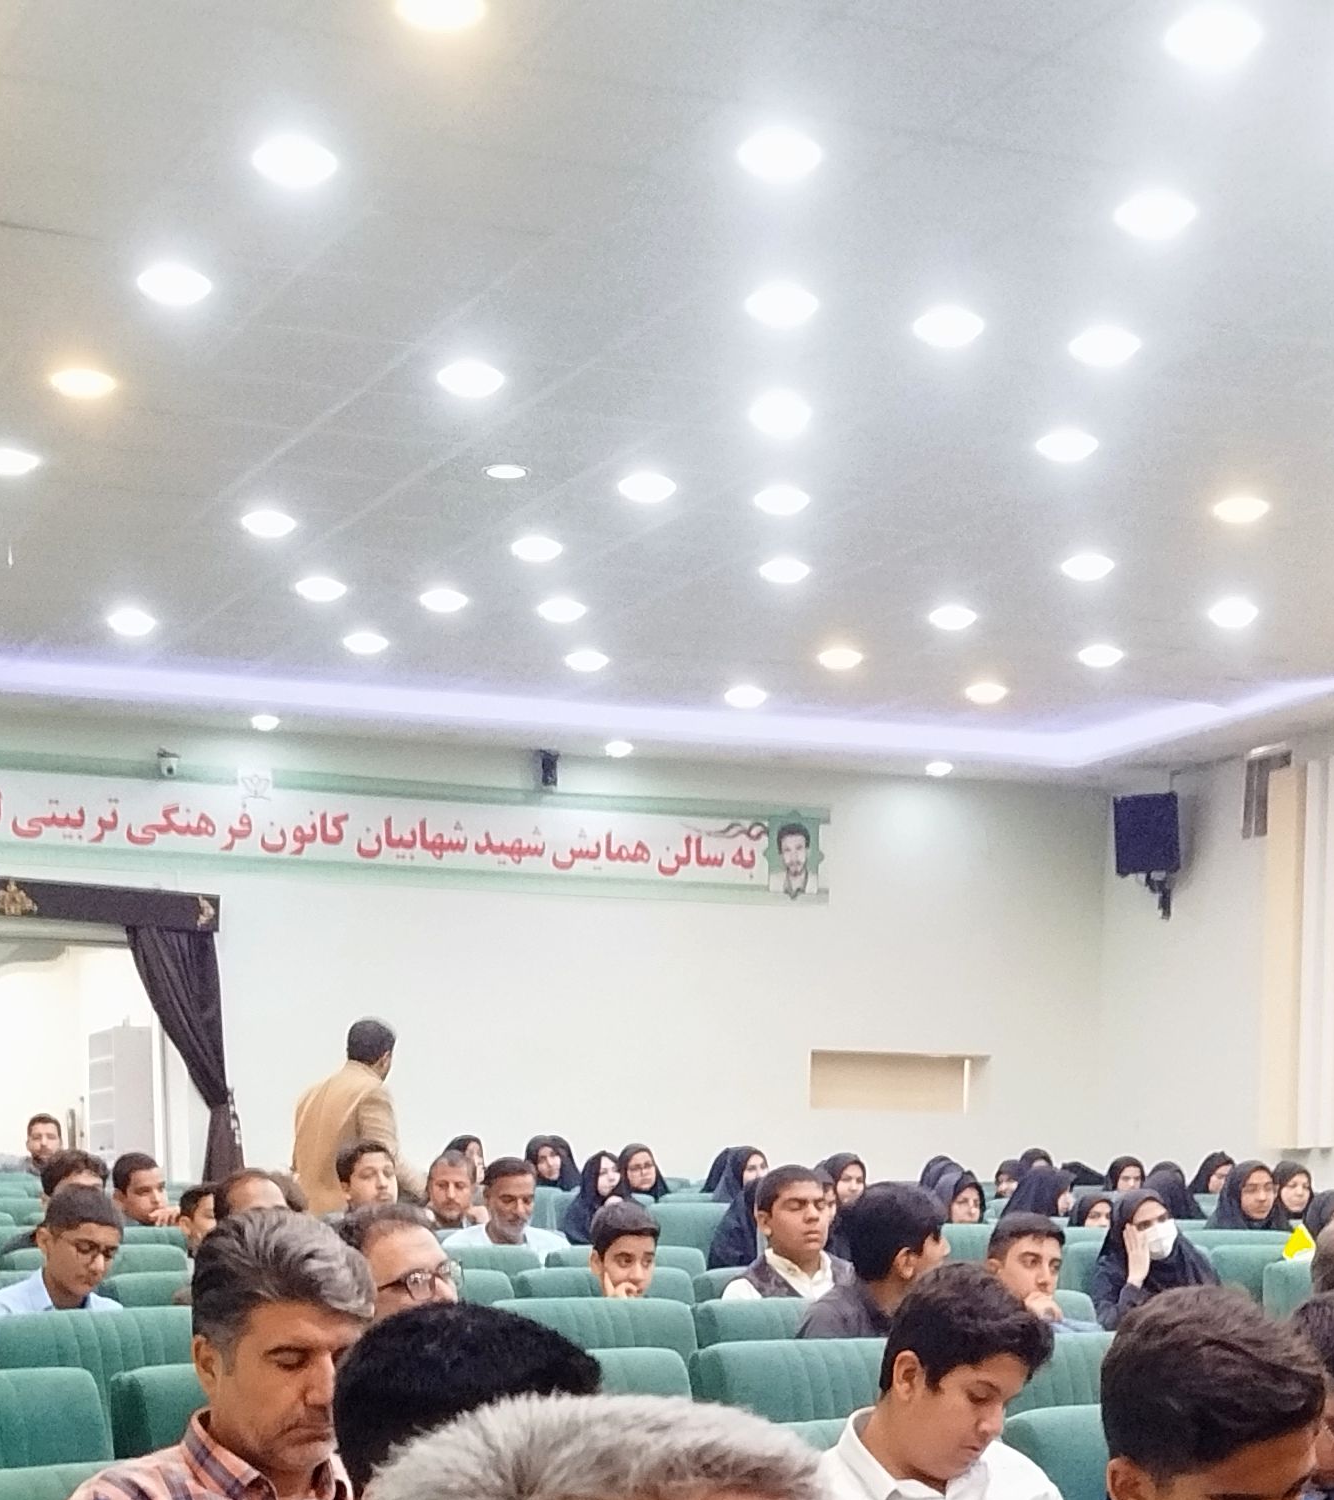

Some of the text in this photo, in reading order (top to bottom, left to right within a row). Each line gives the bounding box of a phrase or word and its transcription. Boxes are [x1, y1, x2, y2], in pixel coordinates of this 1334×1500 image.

[12, 797, 120, 842] تربیتی
[125, 801, 254, 850] فرهنگی
[259, 809, 350, 856] کانون
[356, 816, 468, 861] شهابیان
[474, 825, 546, 866] شهید
[551, 826, 651, 871] همایش
[656, 834, 726, 876] سالن
[731, 841, 757, 879] به
